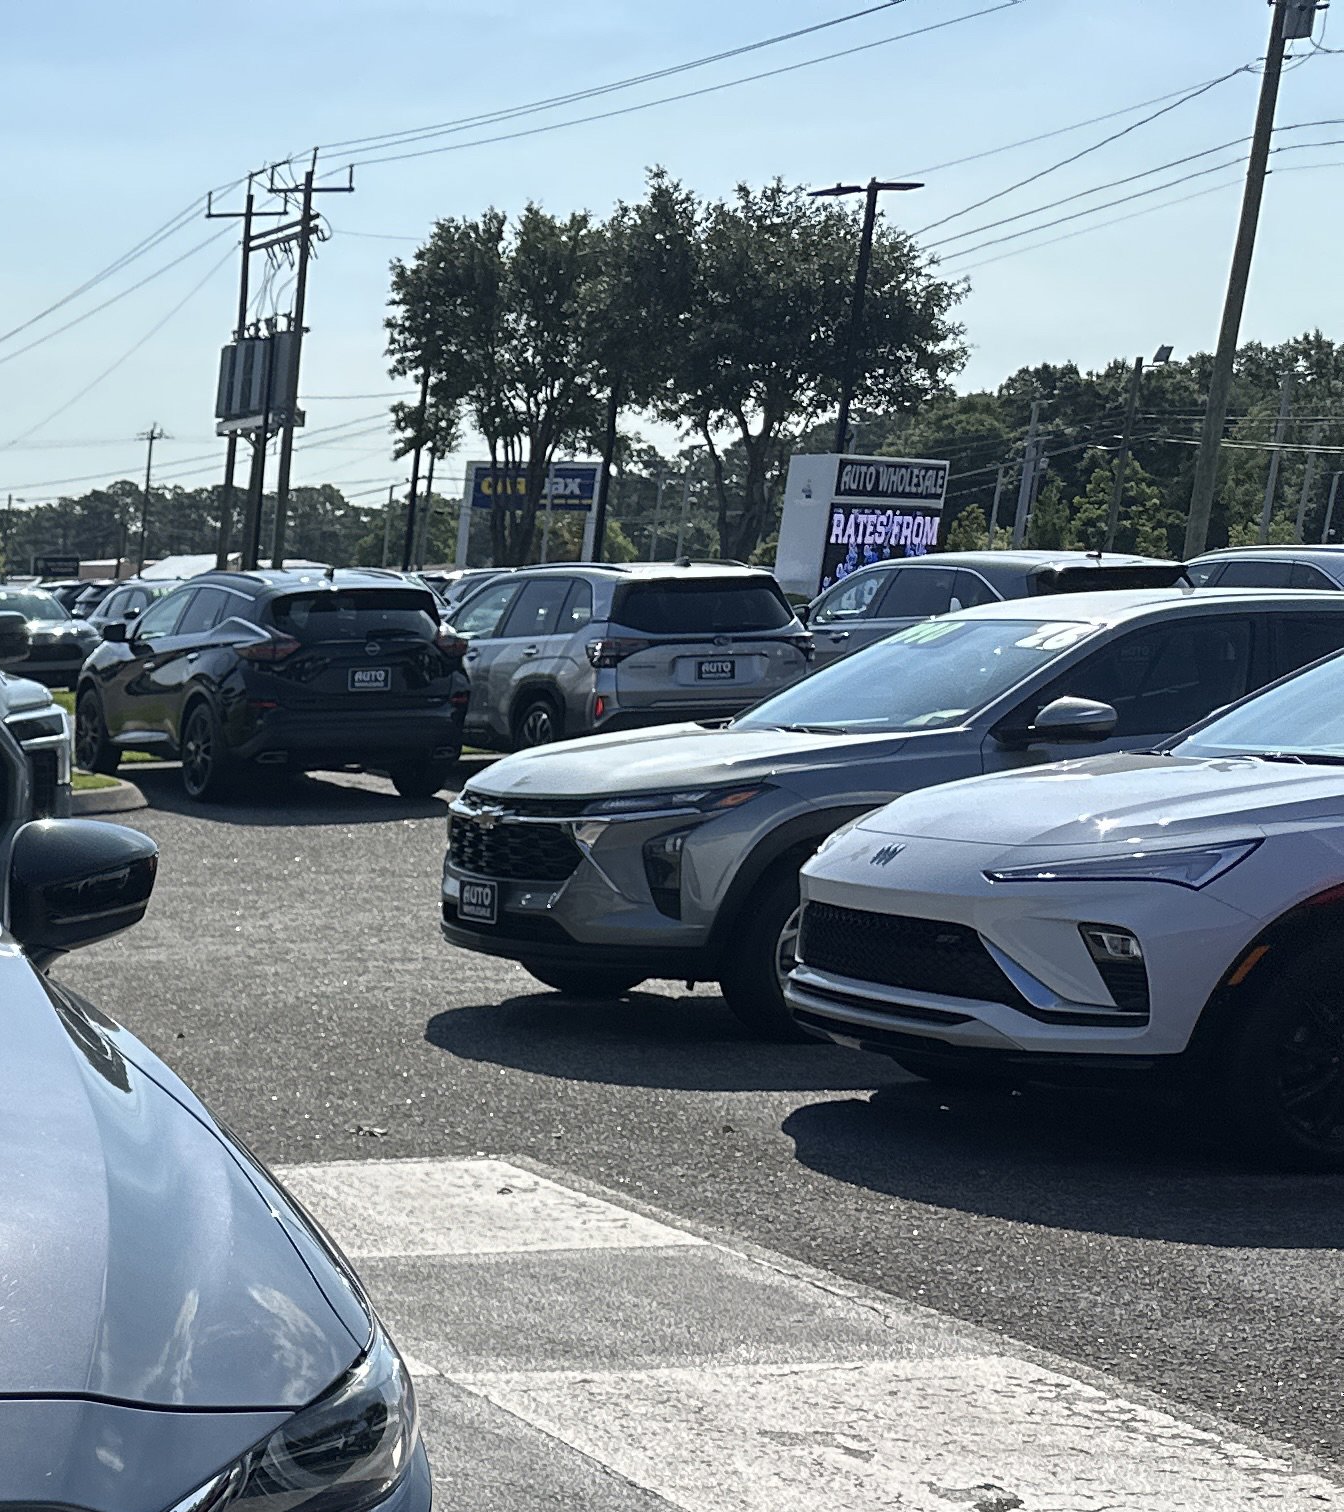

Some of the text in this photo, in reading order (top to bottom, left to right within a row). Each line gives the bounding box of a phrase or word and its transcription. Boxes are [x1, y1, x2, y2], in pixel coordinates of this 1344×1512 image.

[841, 464, 944, 495] AUTO WHOLESALE
[830, 513, 940, 546] RATES FROM
[354, 670, 385, 682] AUTO
[702, 661, 731, 672] AUTO
[463, 885, 491, 906] AUTO
